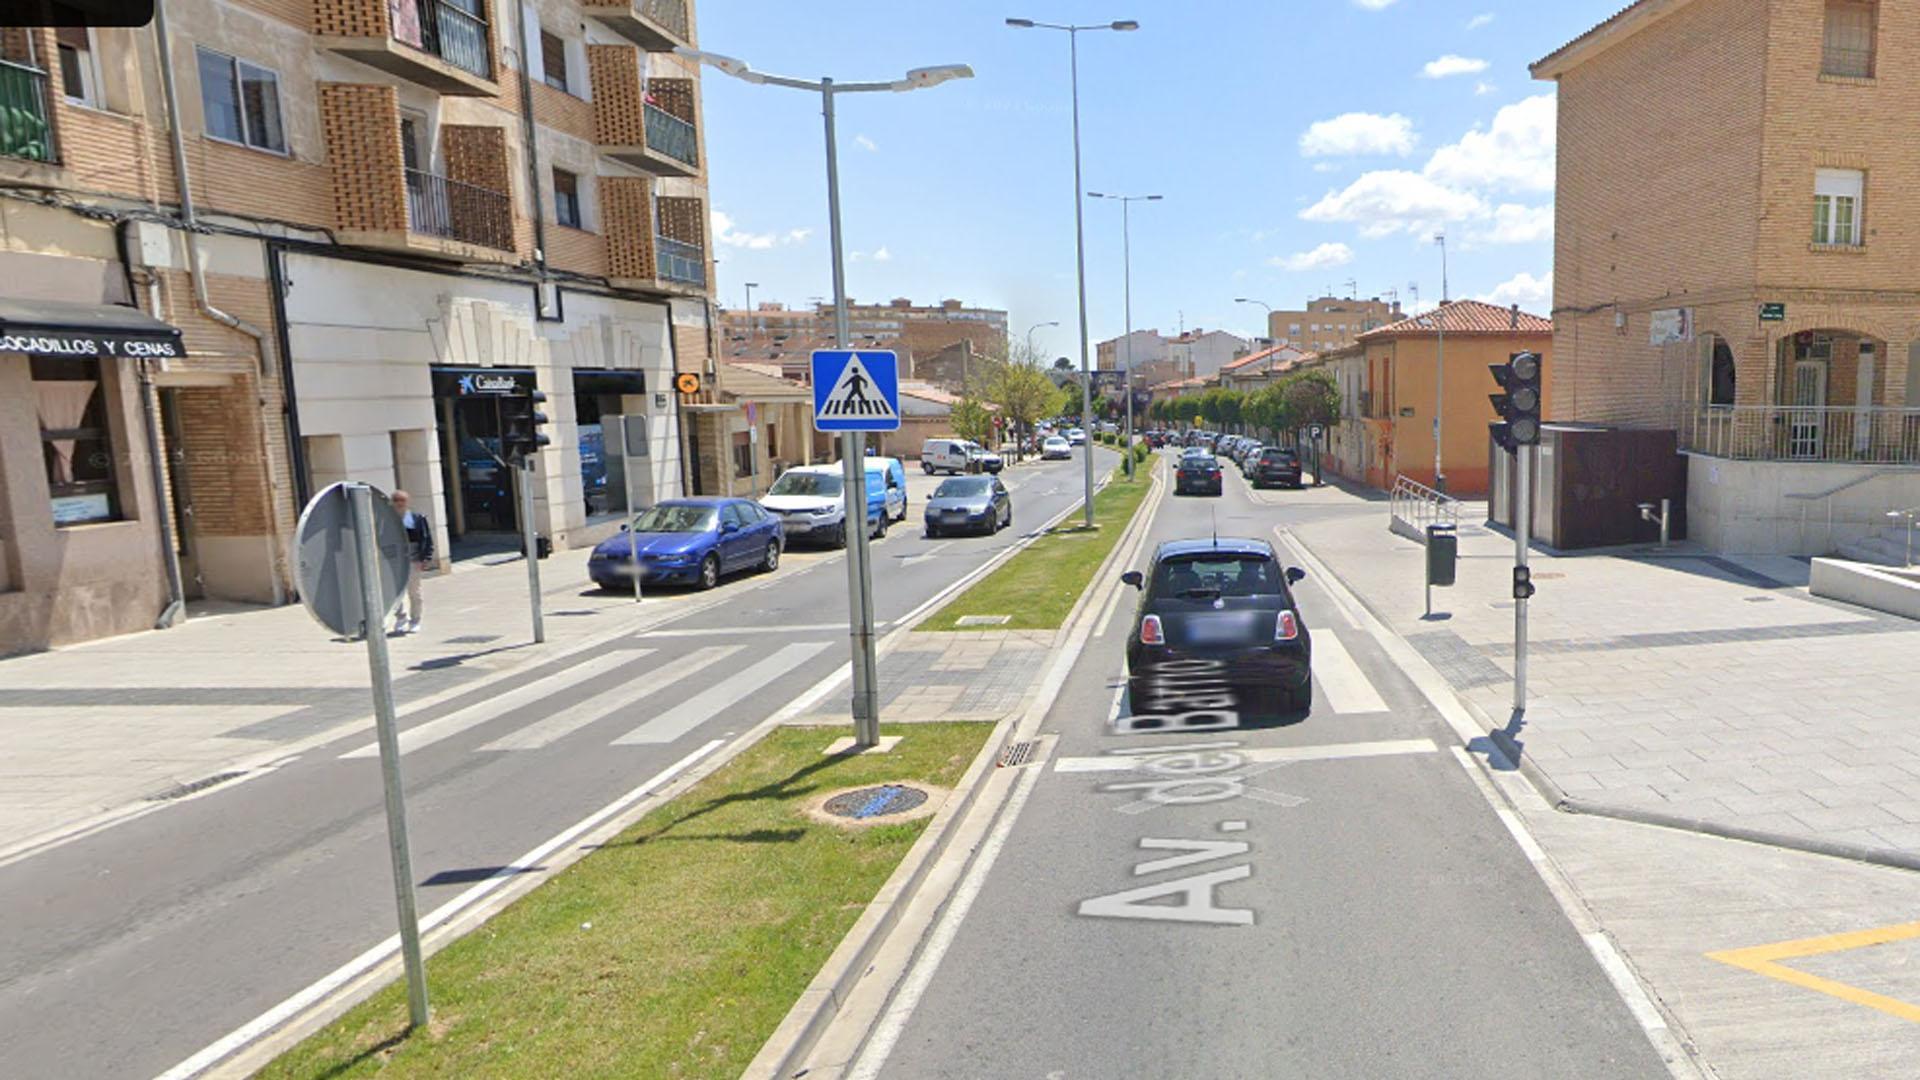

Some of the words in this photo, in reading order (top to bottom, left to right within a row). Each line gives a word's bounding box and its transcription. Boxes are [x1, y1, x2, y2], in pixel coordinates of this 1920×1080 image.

[104, 341, 116, 355] Y
[124, 341, 176, 357] CENAS
[1311, 426, 1320, 438] P
